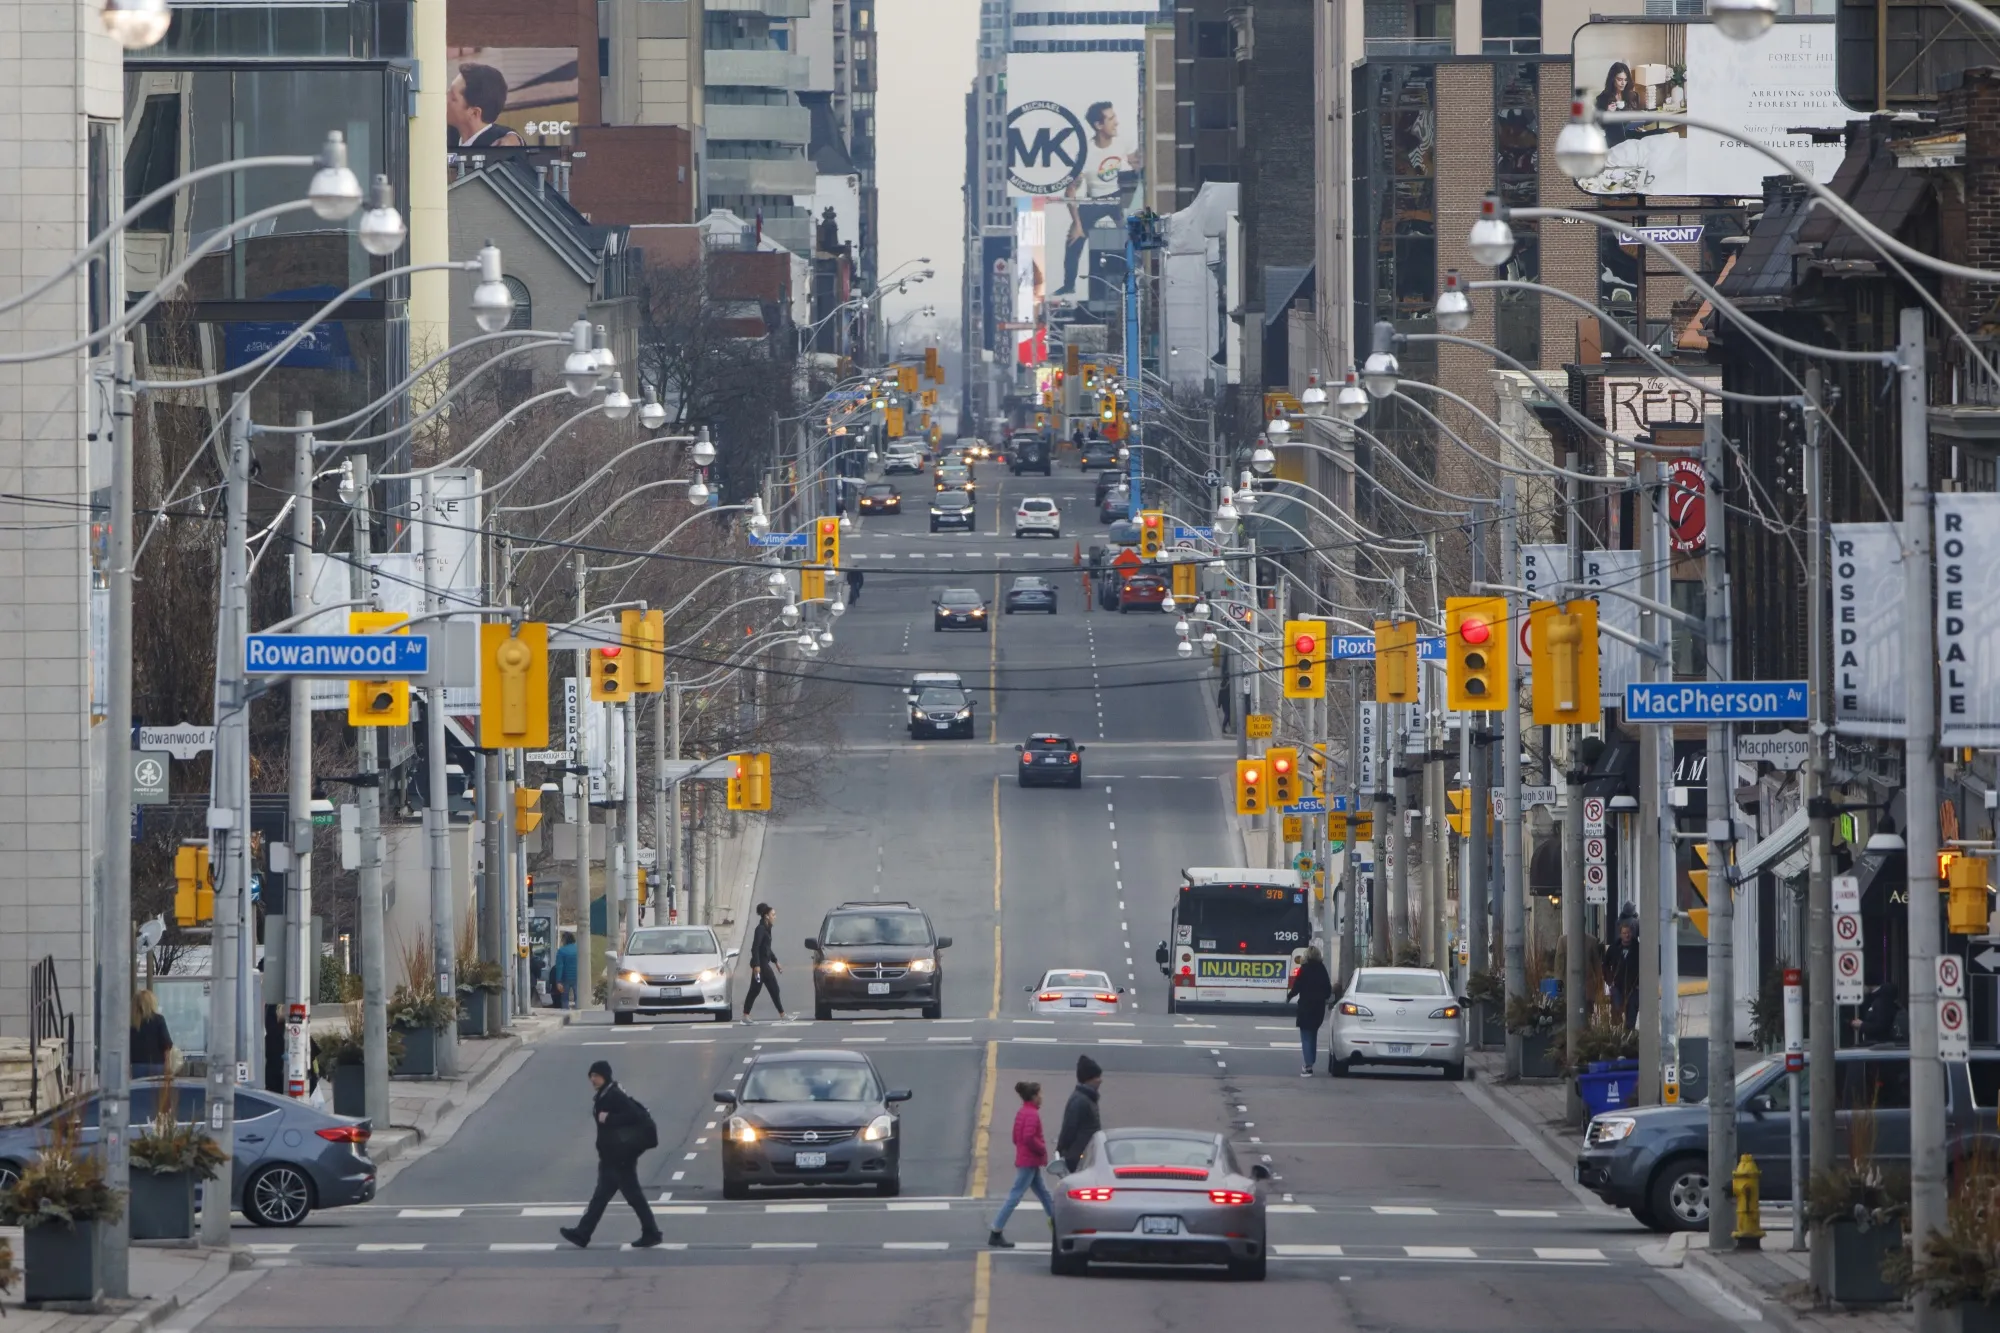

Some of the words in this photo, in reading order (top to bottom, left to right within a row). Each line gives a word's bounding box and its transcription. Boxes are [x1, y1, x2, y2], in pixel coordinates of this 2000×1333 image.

[1021, 101, 1061, 113] MICHAEL
[539, 121, 571, 135] CBC
[1743, 124, 1768, 132] Suites
[1007, 127, 1075, 168] MK
[1009, 175, 1049, 193] MICHAEL
[1051, 175, 1074, 191] KORS
[1621, 228, 1698, 242] OTFRONT
[1646, 377, 1669, 390] The
[1944, 513, 1966, 714] ROSEDALE
[1838, 541, 1858, 711] ROSEDALE
[249, 639, 397, 665] Rowanwood
[406, 640, 422, 654] Av
[1632, 688, 1778, 714] MacPherson
[1787, 687, 1803, 701] Av
[141, 730, 205, 744] Rowanwood
[1362, 708, 1370, 783] ROSEDALE
[1739, 740, 1809, 757] Macpherson
[1538, 791, 1545, 800] St
[1547, 791, 1553, 800] W
[1274, 931, 1299, 942] 1296
[1202, 961, 1284, 978] INJURED?
